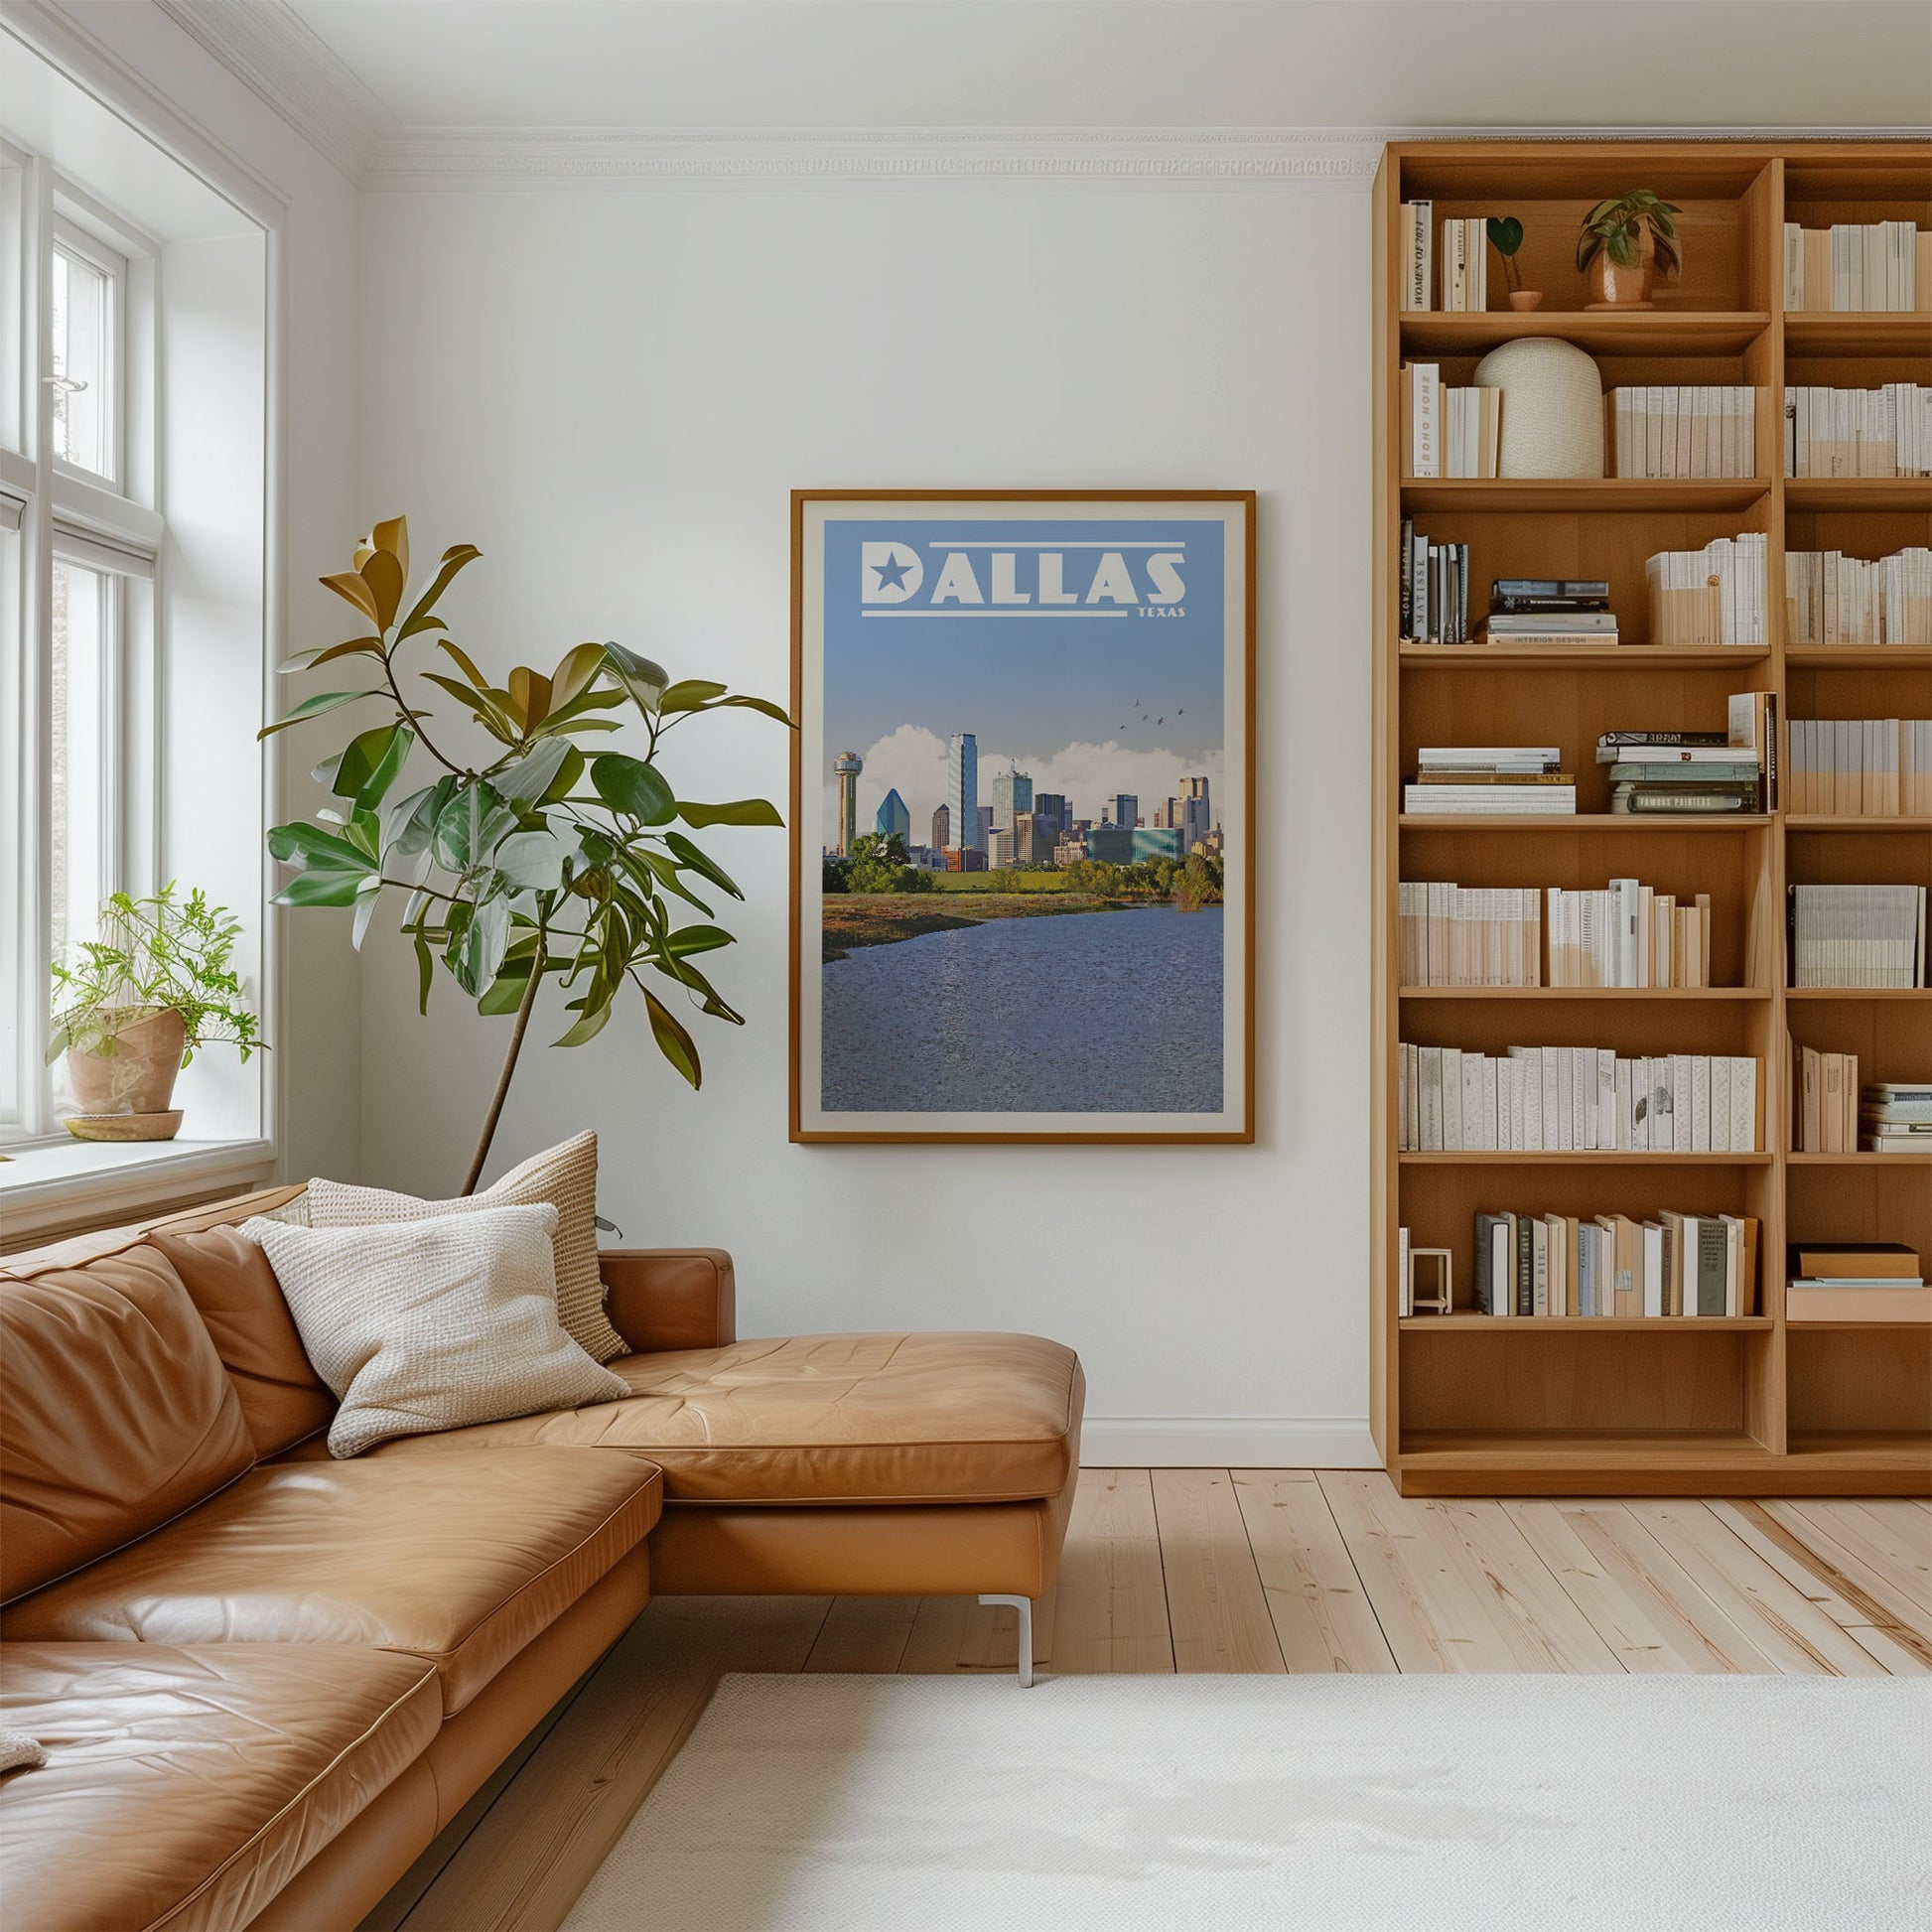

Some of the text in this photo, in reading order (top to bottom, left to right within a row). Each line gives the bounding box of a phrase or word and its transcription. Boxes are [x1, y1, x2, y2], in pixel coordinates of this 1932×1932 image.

[1415, 244, 1424, 260] OF
[1414, 262, 1424, 305] WOMEN
[862, 541, 1185, 605] DALLAS
[1416, 560, 1425, 624] MATISSE
[1137, 607, 1185, 618] TEXAS
[1639, 797, 1671, 807] FAMOUS
